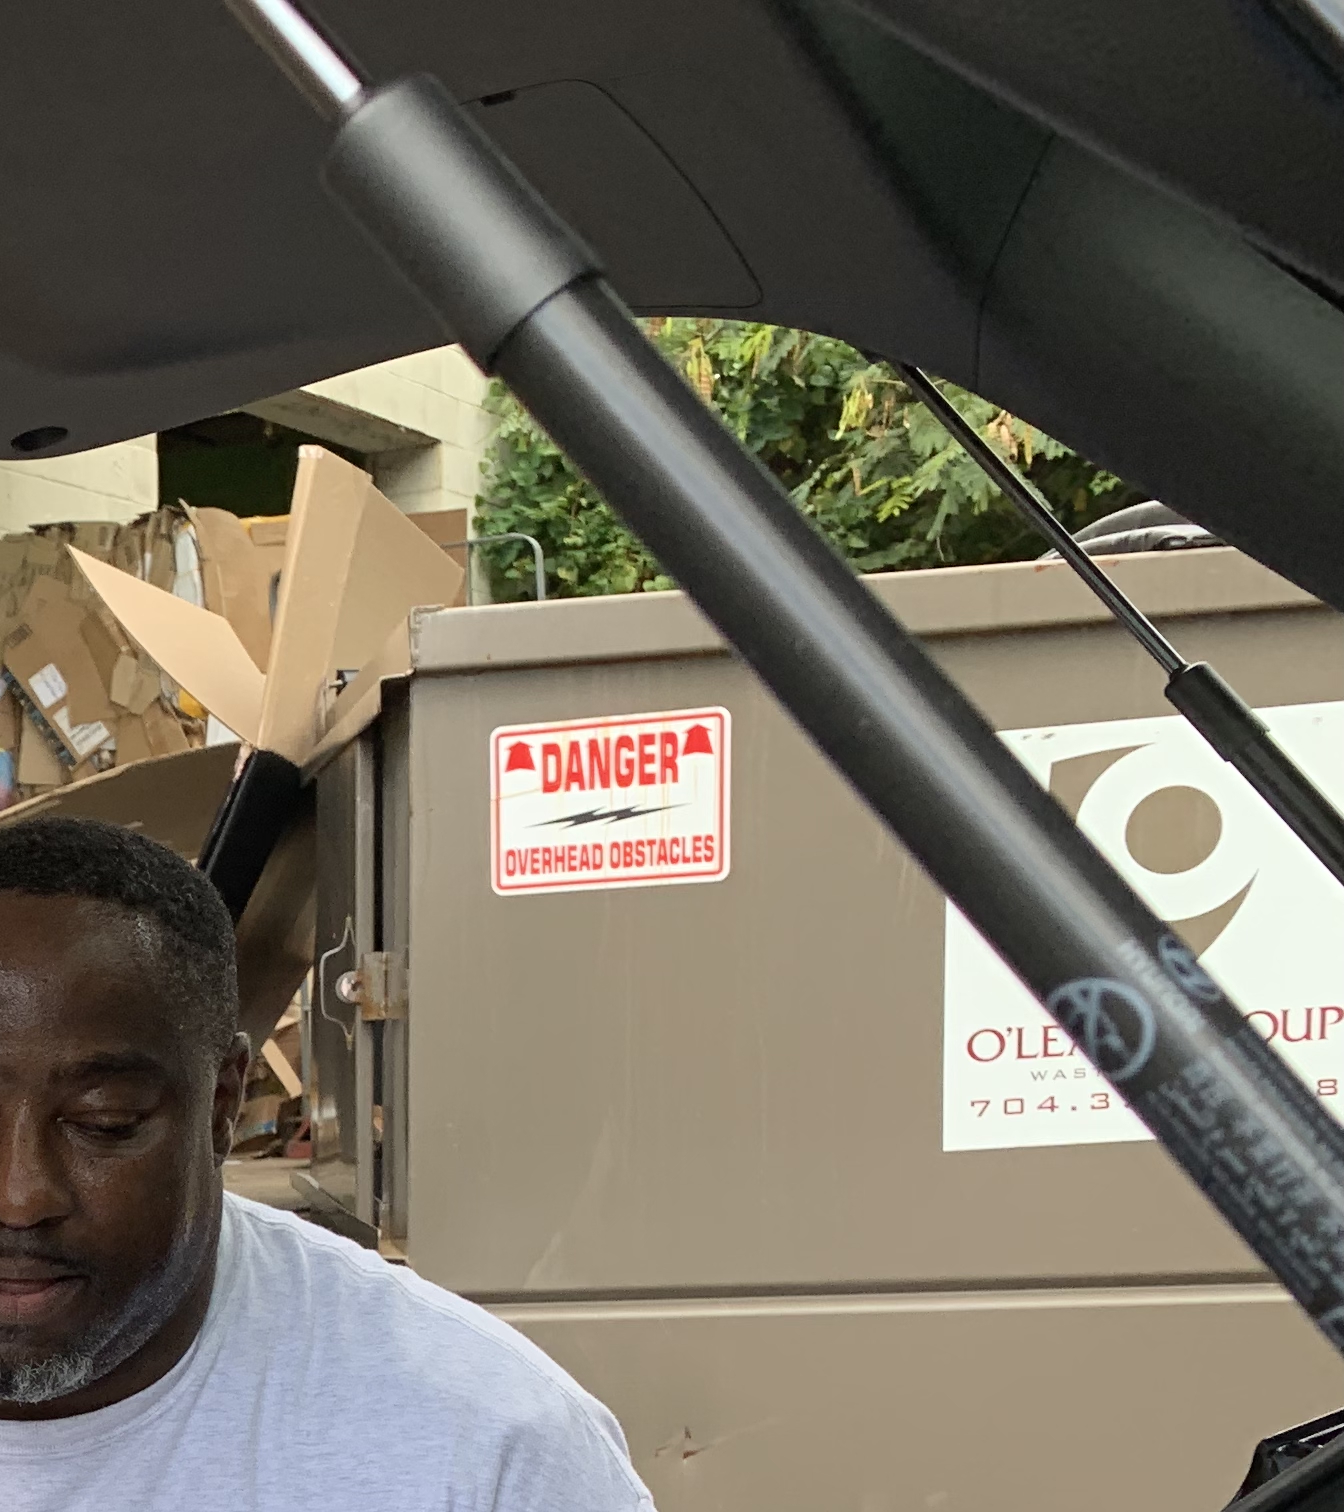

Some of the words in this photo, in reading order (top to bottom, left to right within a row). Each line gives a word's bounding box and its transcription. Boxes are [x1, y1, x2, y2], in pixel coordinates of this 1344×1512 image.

[541, 731, 679, 794] DANGER
[505, 842, 604, 878] OVERHEAD
[611, 834, 715, 870] OBSTACLES
[966, 1024, 1079, 1064] O'LE
[1242, 1006, 1344, 1045] OUP
[1030, 1067, 1090, 1082] WAS
